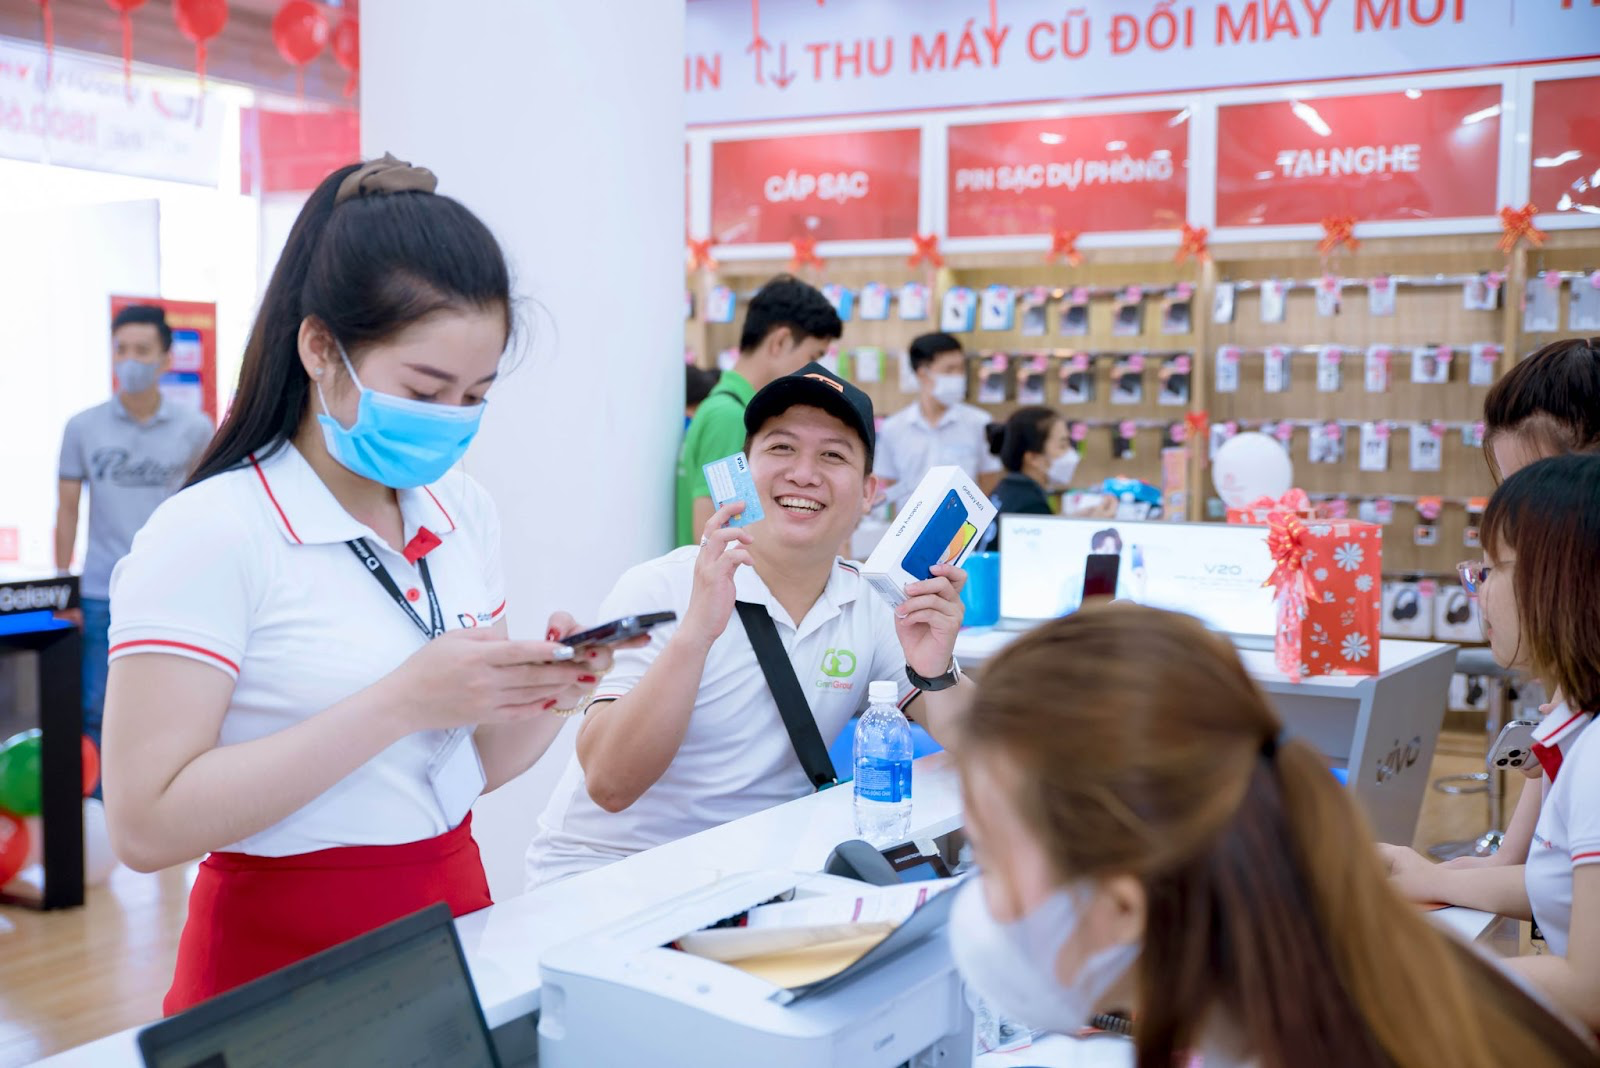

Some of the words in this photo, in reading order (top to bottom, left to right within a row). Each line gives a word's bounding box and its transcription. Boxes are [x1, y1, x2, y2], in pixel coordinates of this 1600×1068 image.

[805, 37, 894, 81] THU
[910, 18, 1010, 73] MÁY
[1026, 9, 1091, 62] CŨ
[1329, 143, 1421, 176] NGHE
[764, 168, 817, 202] CÁP
[817, 171, 870, 204] SẠC
[955, 168, 995, 192] PIN
[996, 164, 1045, 194] SẠC
[737, 456, 745, 471] VISA
[962, 485, 977, 504] Galaxy
[1204, 563, 1242, 576] V20
